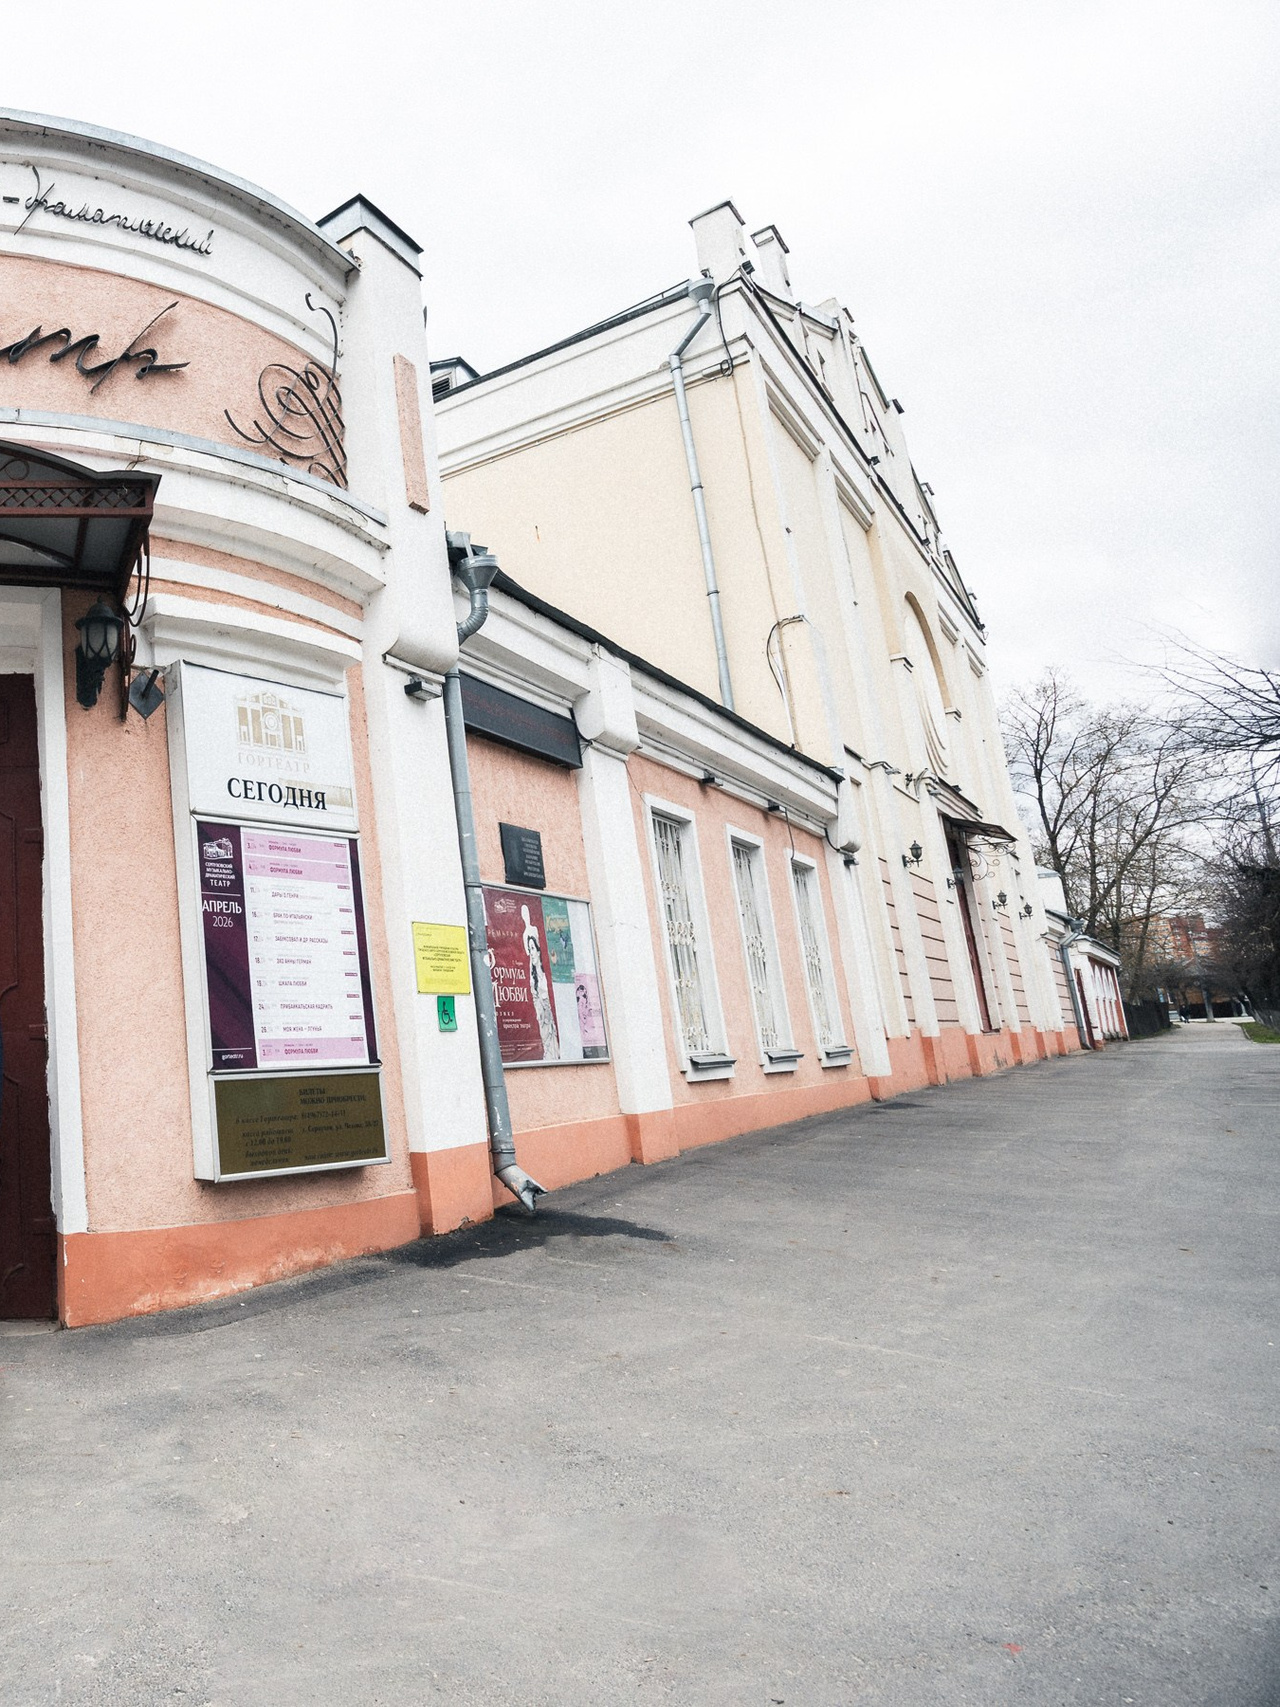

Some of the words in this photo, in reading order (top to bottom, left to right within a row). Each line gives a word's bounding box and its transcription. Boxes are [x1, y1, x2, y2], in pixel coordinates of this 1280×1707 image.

[237, 752, 310, 773] ГОРТЕАТР
[227, 777, 327, 810] СЕГОДНЯ
[210, 879, 231, 887] ТЕАТР
[202, 900, 242, 914] АПРЕЛЬ
[212, 915, 234, 928] 2026
